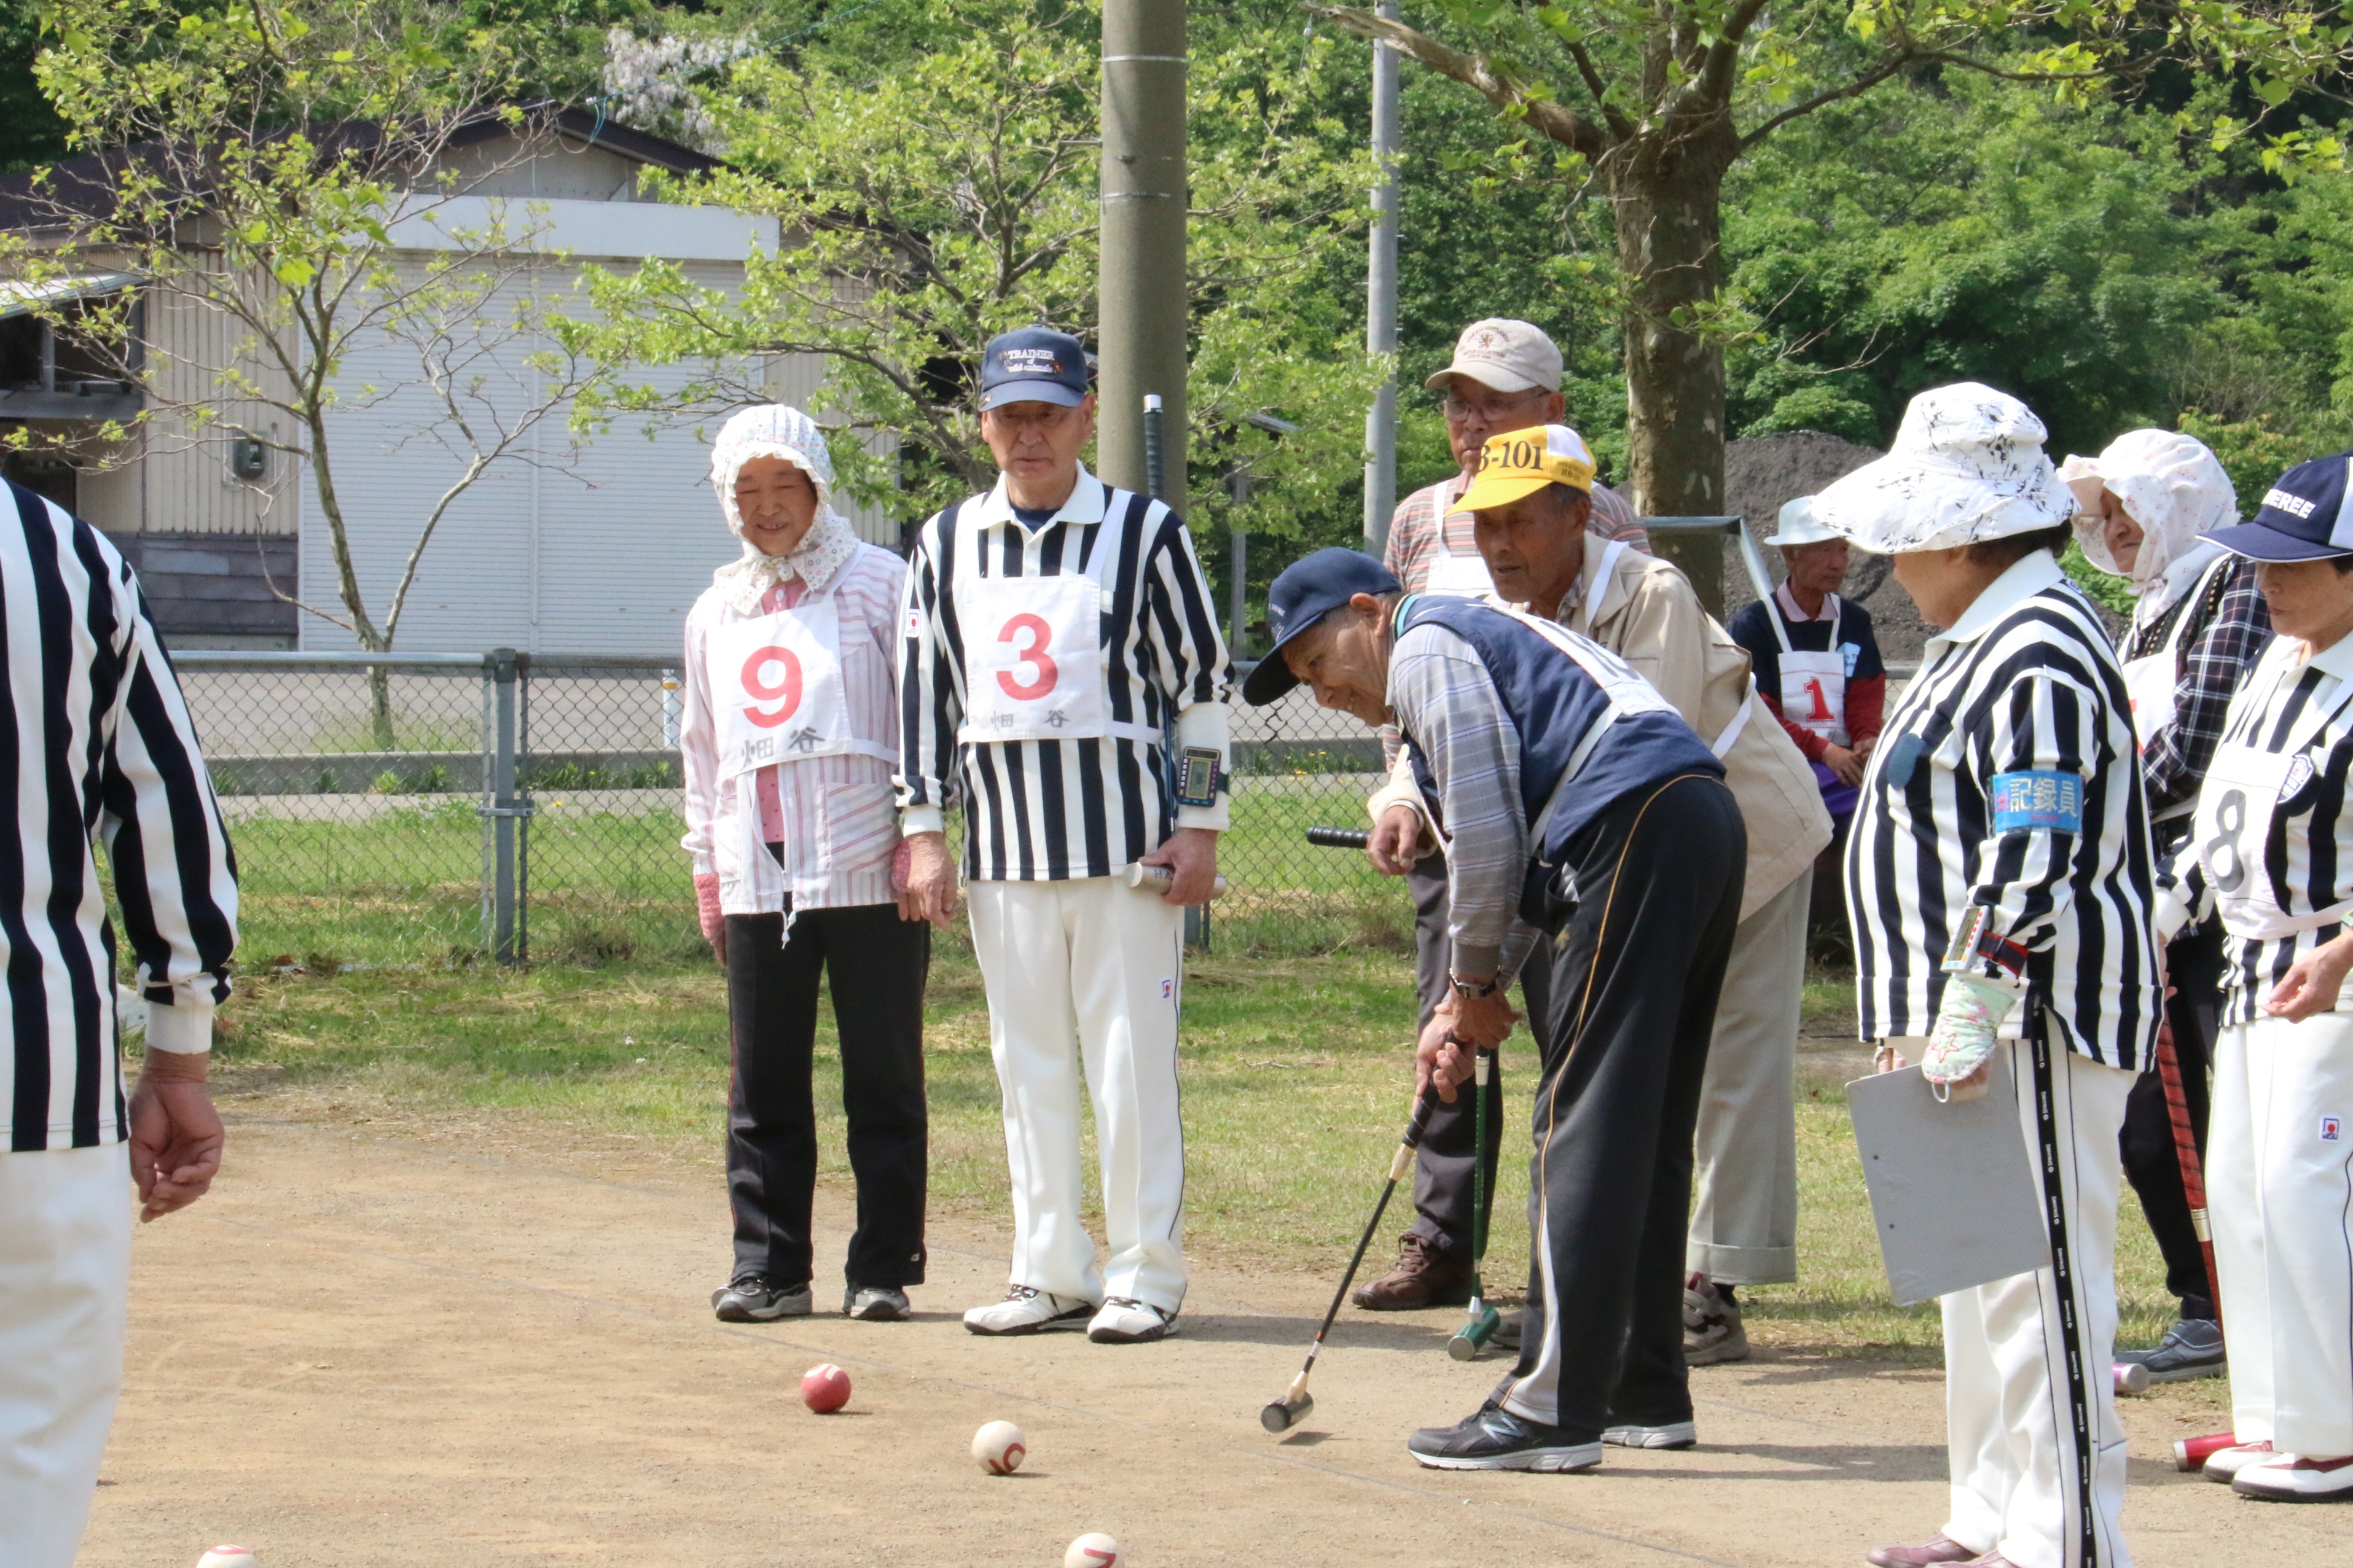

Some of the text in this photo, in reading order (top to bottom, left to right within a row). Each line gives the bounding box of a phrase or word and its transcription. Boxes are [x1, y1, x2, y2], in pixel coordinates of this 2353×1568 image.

[1008, 349, 1055, 361] TRAINER
[741, 646, 803, 728] 9
[996, 612, 1058, 701] 3
[1804, 676, 1835, 722] 1
[2010, 778, 2078, 817] 記録員
[2206, 789, 2247, 892] 8
